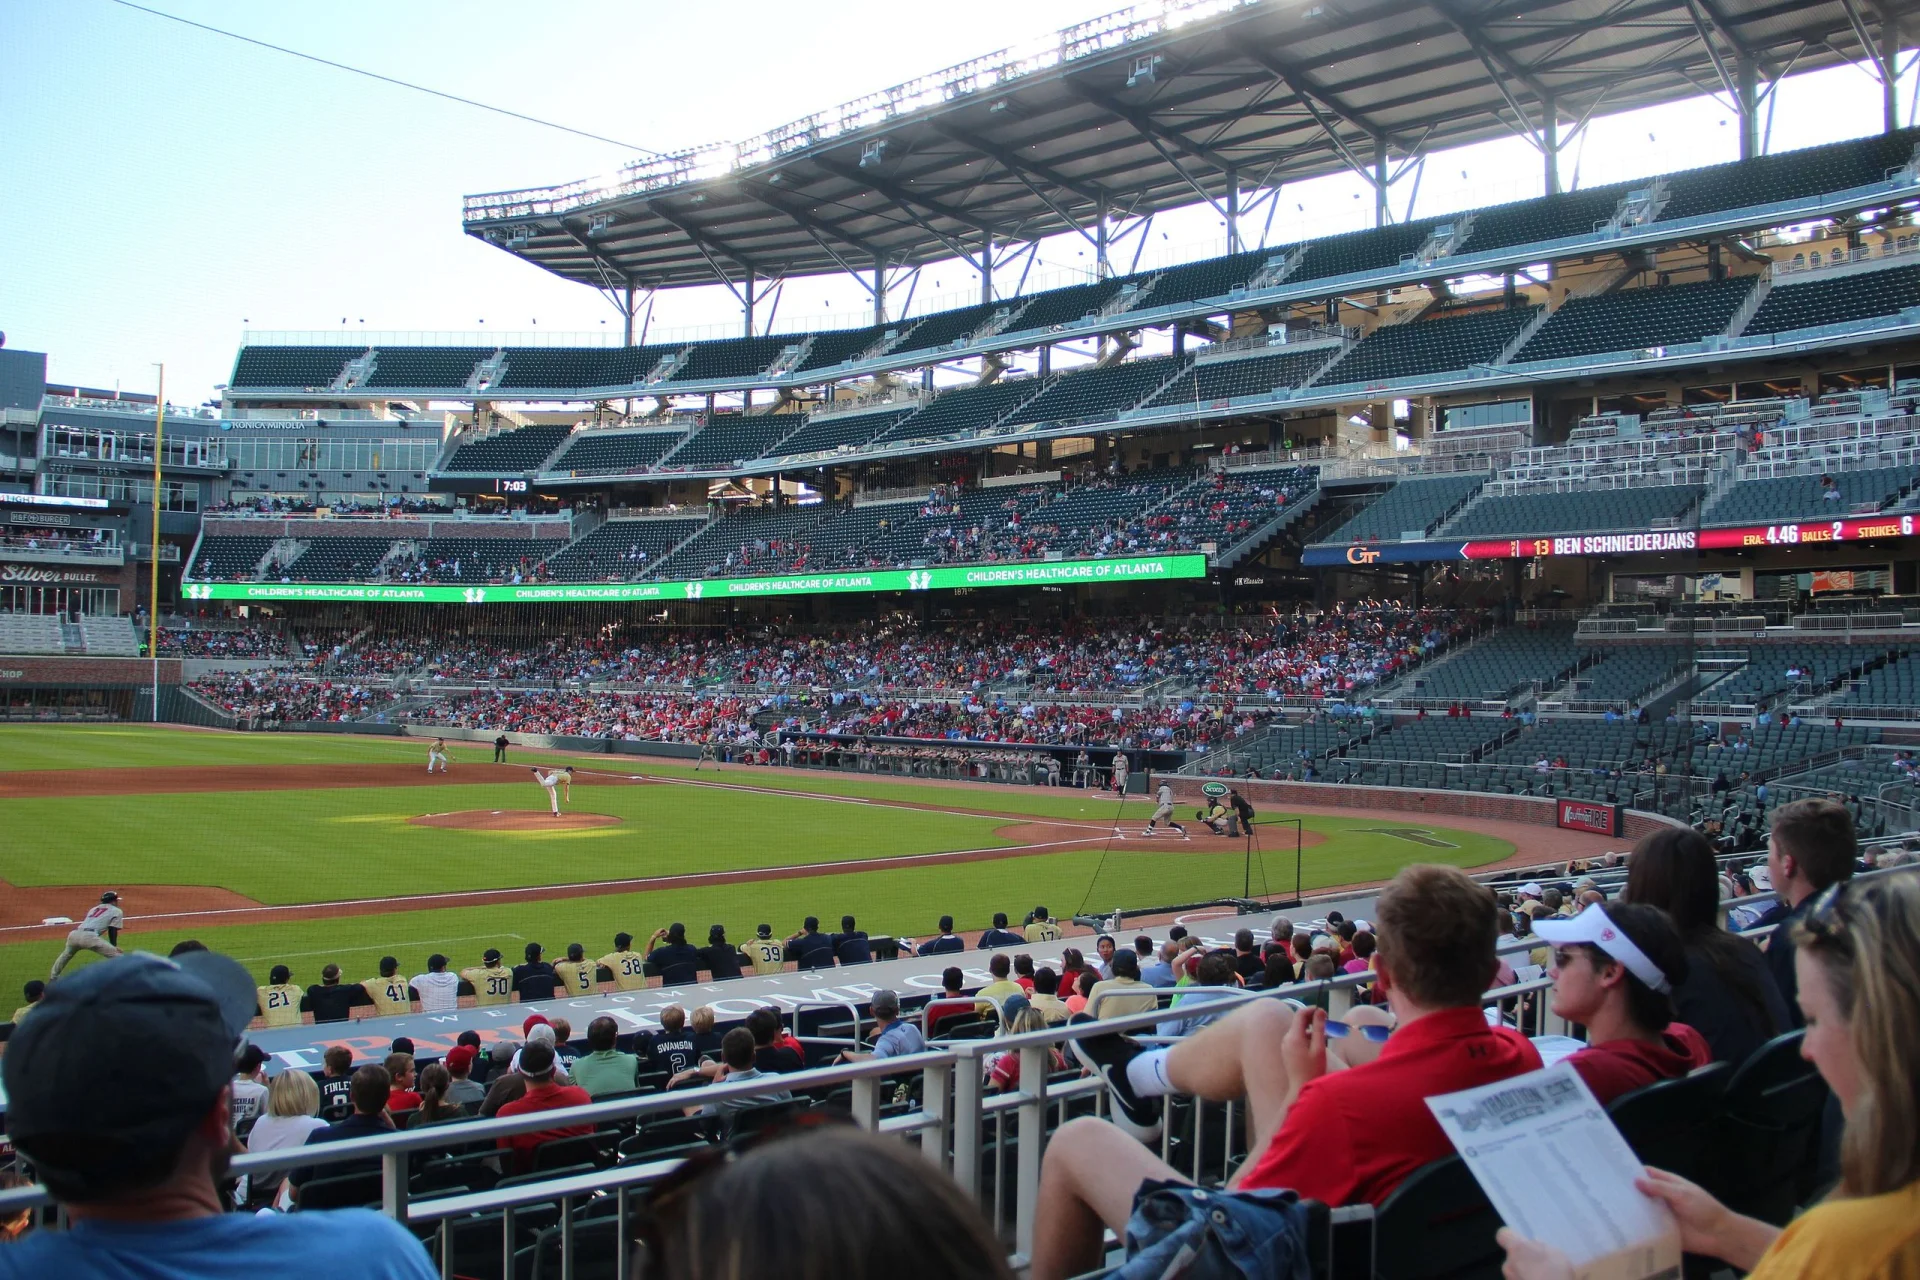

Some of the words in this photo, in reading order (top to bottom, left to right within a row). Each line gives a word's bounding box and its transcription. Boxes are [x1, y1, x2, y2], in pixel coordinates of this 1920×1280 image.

[232, 421, 265, 430] KONICA
[267, 421, 305, 430] MINOLTA
[503, 481, 527, 491] 7:03
[39, 515, 69, 524] BURGER
[1743, 534, 1765, 546] ERA:
[1766, 525, 1798, 544] 4.46
[1801, 530, 1832, 542] BALLS:
[1832, 521, 1843, 540] 2
[1858, 525, 1901, 539] STRIKES:
[1902, 515, 1913, 535] 6
[1533, 540, 1549, 556] 13
[1554, 537, 1581, 555] BEN
[1584, 532, 1696, 554] SCHNIEDERJANS
[2, 564, 62, 582] Silver
[967, 569, 1024, 582] CHILDREN'S
[1025, 566, 1093, 579] HEALTHCARE
[1096, 564, 1111, 576] OF
[1113, 562, 1164, 575] ATLANTA
[248, 588, 303, 597] CHILDREN'S
[305, 589, 364, 598] HEALTHCARE
[367, 589, 380, 598] OF
[382, 590, 425, 598] ATLANTA
[516, 589, 564, 598] CHILDREN'S
[566, 588, 619, 597] HEALTHCARE
[622, 588, 631, 597] OF
[632, 587, 660, 596] ATLANTA
[728, 582, 771, 592] CHILDREN'S
[772, 579, 821, 591] HEALTHCARE
[822, 578, 834, 588] OF
[835, 577, 872, 587] ATLANTA
[1584, 807, 1608, 829] TIRE
[1040, 931, 1054, 942] 17
[760, 946, 781, 962] 39
[620, 958, 642, 976] 38
[486, 977, 508, 995] 30
[579, 971, 590, 989] 5
[268, 991, 290, 1009] 21
[386, 984, 406, 1001] 41
[428, 987, 724, 1024] WELCOME
[763, 974, 823, 985] TO
[656, 1041, 693, 1053] SWANSON
[670, 1053, 687, 1074] 2
[323, 1081, 351, 1095] FINLE
